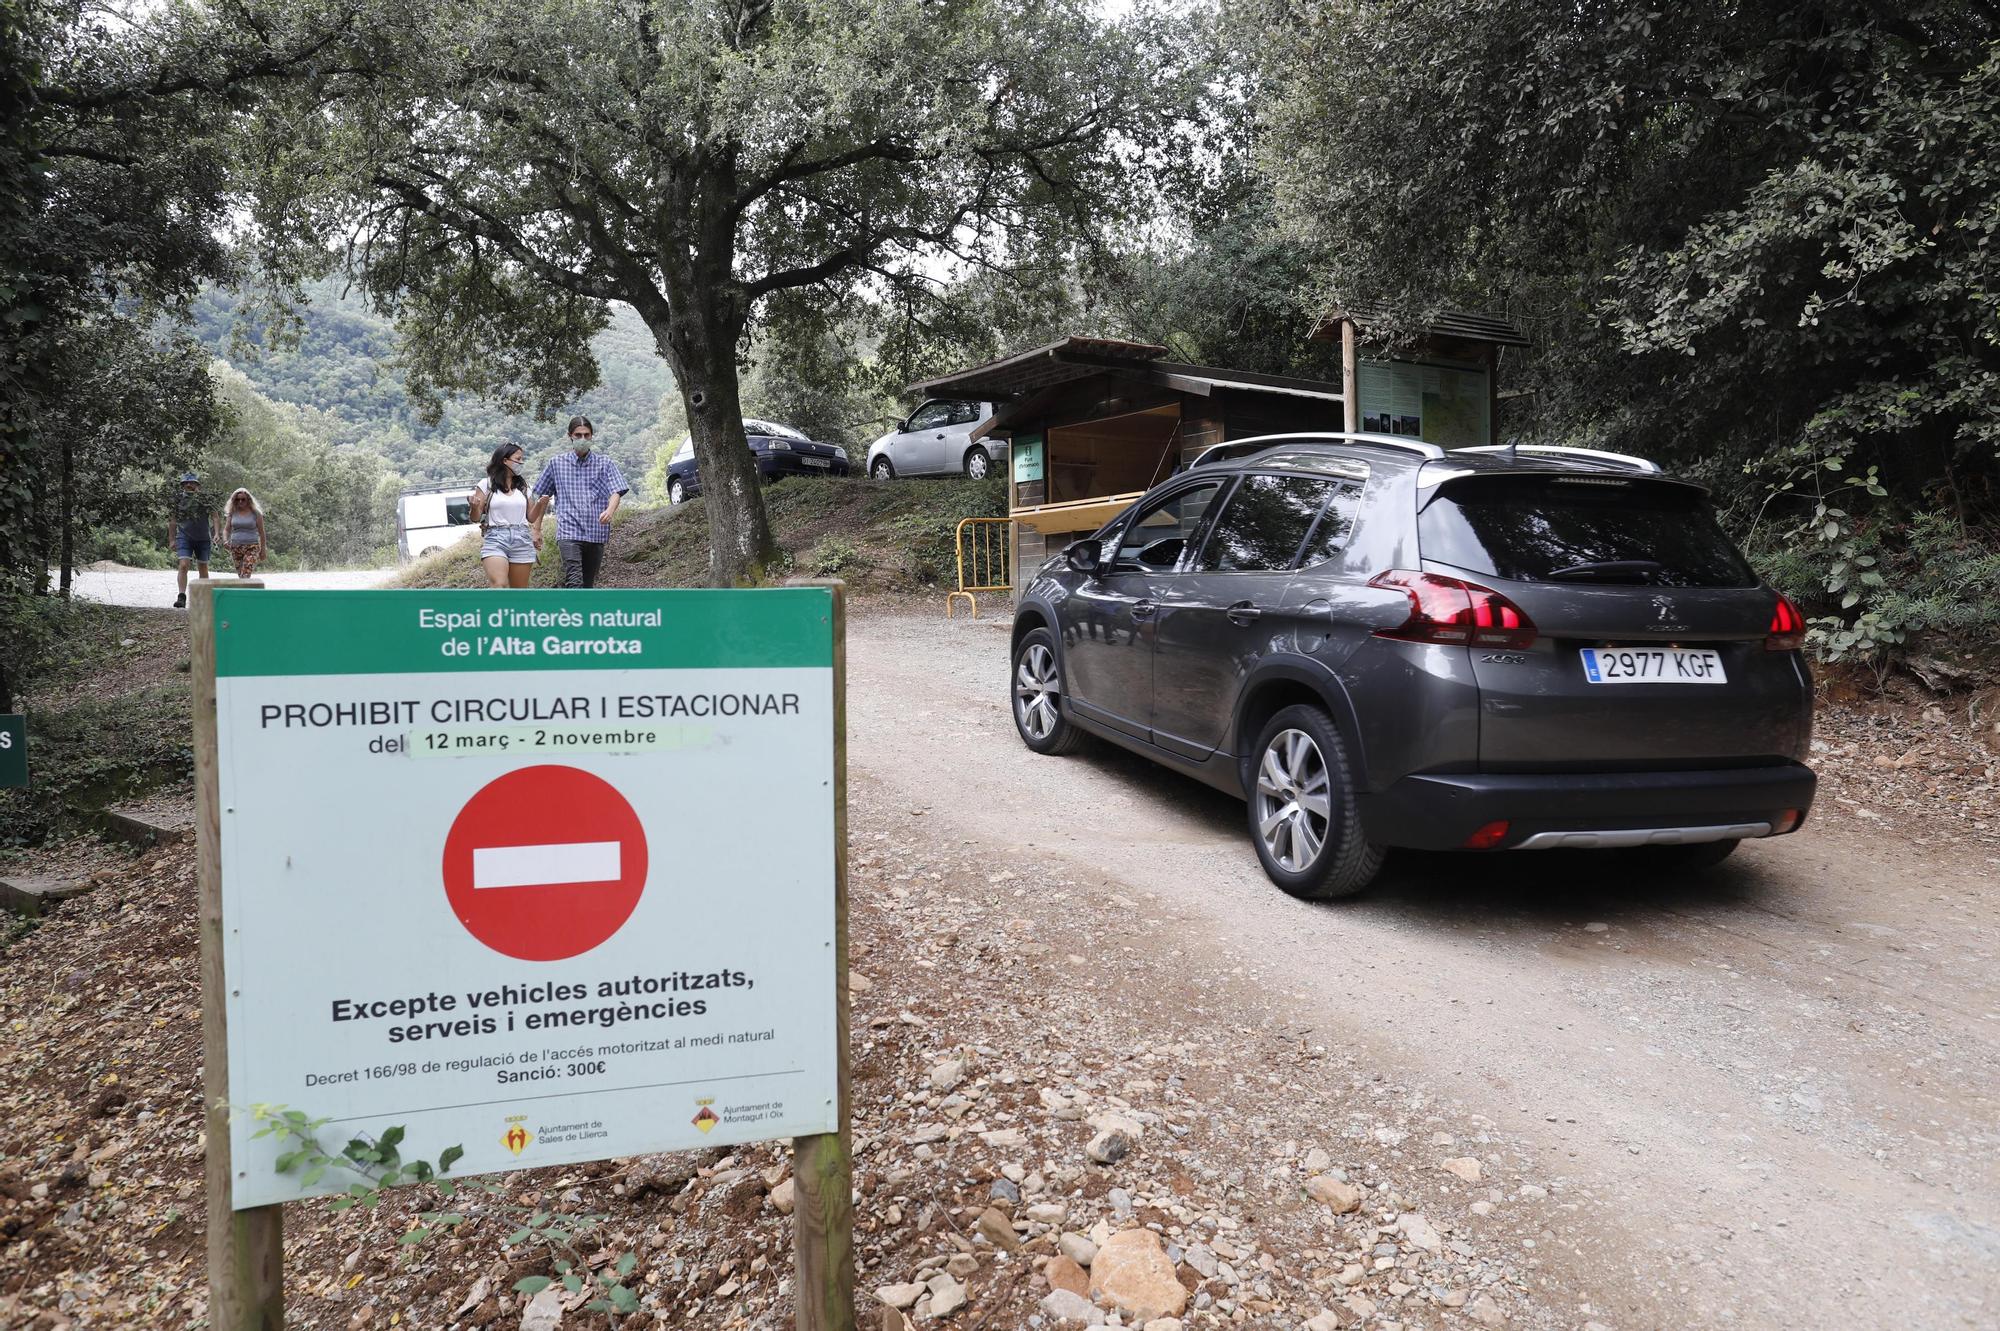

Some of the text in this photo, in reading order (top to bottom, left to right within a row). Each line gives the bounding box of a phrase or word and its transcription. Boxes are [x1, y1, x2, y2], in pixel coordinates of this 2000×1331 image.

[419, 608, 482, 632] Espai
[589, 608, 662, 627] natural
[441, 637, 471, 657] de
[542, 635, 642, 656] Garrotxa
[1590, 668, 1598, 677] E
[1602, 652, 1715, 678] 2977 KGF
[260, 693, 800, 729] PROHIBIT CIRCULAR I ESTACIONAR
[368, 733, 404, 754] del
[424, 732, 449, 750] 12
[455, 733, 510, 751] març
[534, 729, 546, 746] 2
[552, 729, 656, 746] novembre
[331, 968, 754, 1022] Excepte vehicles autoritzats,
[388, 997, 708, 1043] serveis i emergències
[305, 1069, 359, 1087] Decret
[364, 1062, 417, 1080] 166/98
[421, 1060, 441, 1074] de
[445, 1052, 515, 1073] regulació
[519, 1050, 538, 1064] de
[598, 1038, 670, 1056] motoritzat
[673, 1036, 686, 1049] al
[690, 1033, 724, 1048] medi
[728, 1029, 775, 1045] natural
[497, 1060, 606, 1085] Sanció: 300€
[723, 1101, 783, 1115] Ajuntament de
[723, 1113, 763, 1124] Montagut
[538, 1120, 602, 1136] Ajuntament de
[538, 1129, 608, 1145] Sales de Llierca
